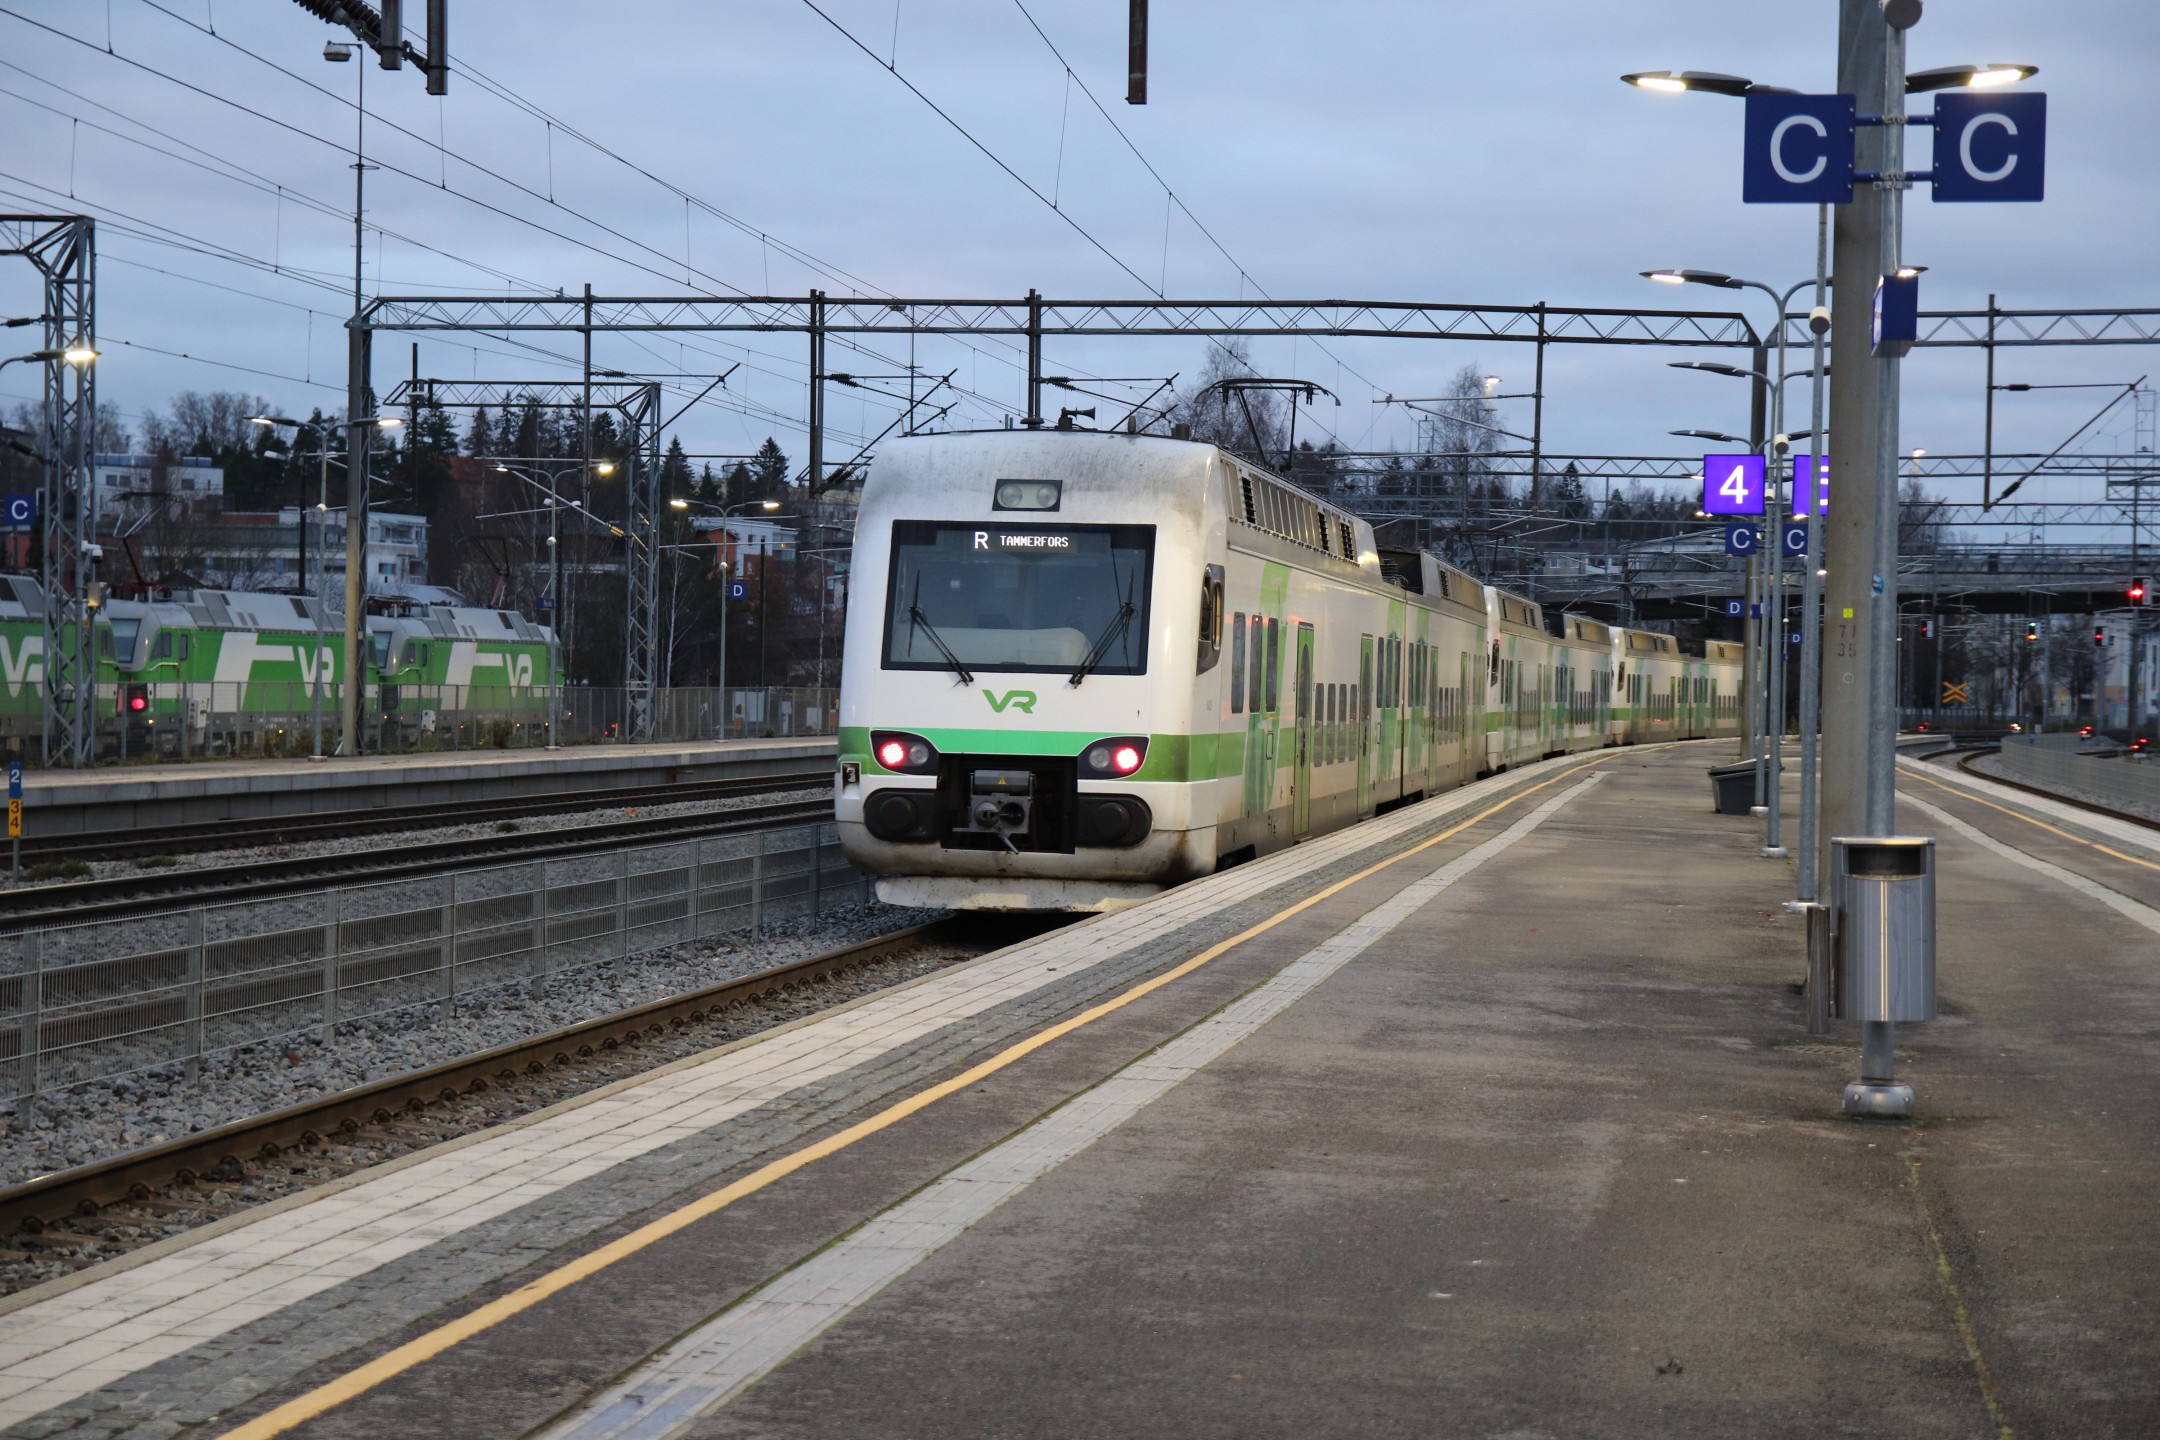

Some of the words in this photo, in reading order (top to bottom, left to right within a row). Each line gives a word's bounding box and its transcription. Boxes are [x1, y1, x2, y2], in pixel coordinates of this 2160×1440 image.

[1769, 114, 1828, 184] C
[1960, 112, 2018, 183] C
[1719, 464, 1749, 505] 4
[11, 499, 28, 520] C
[974, 531, 989, 550] R
[1000, 535, 1069, 548] TAMMERFORS
[1732, 528, 1750, 549] C
[1786, 529, 1805, 550] C
[733, 584, 743, 597] D
[1729, 602, 1741, 614] D
[1792, 633, 1801, 643] D
[298, 645, 335, 698] VR
[505, 652, 533, 699] VR
[982, 689, 1038, 714] VR
[10, 768, 20, 783] 2
